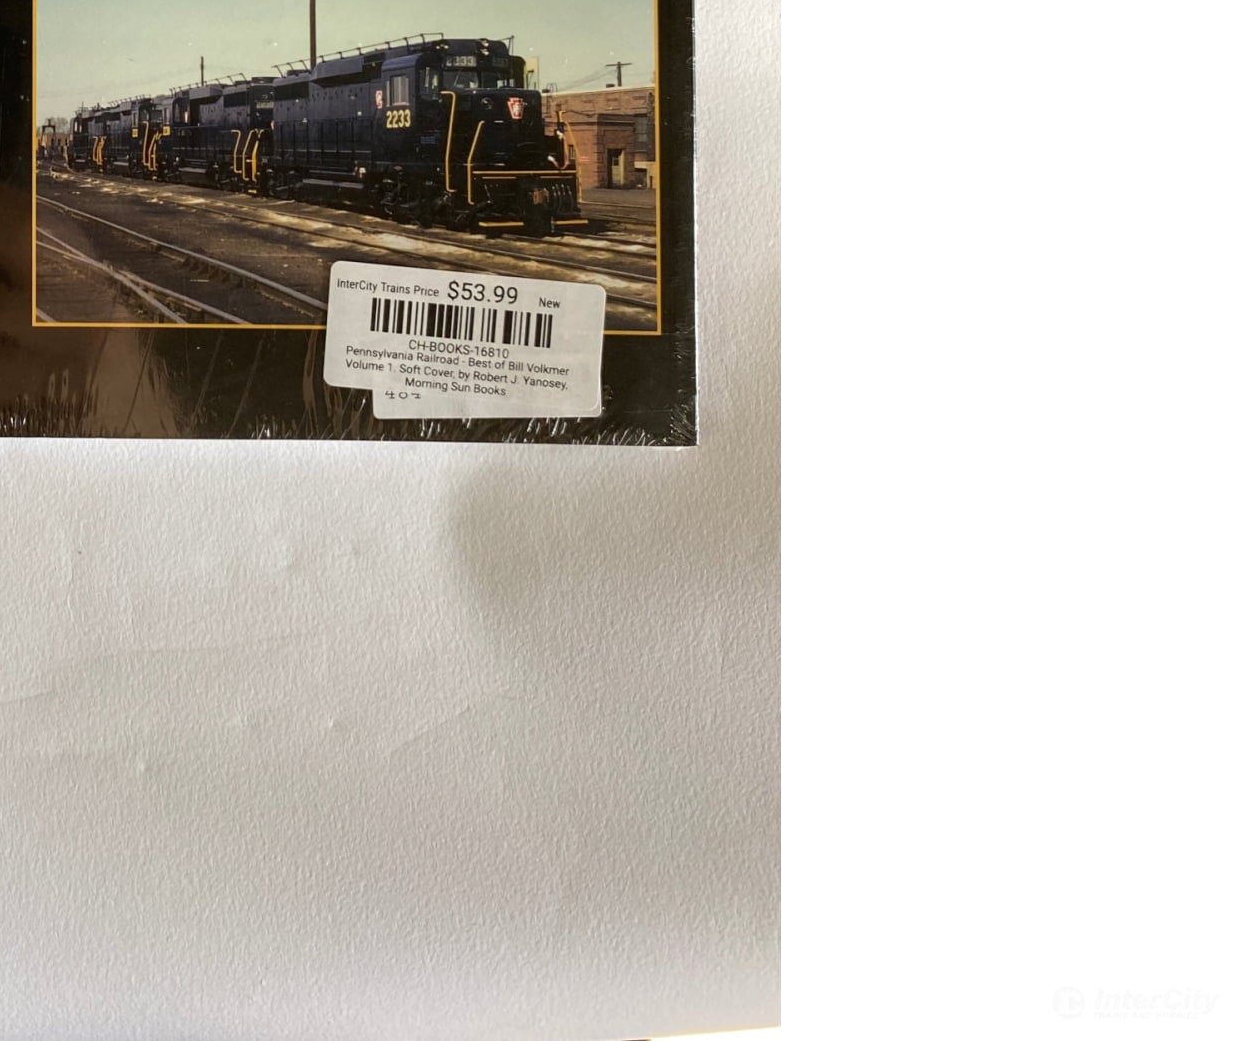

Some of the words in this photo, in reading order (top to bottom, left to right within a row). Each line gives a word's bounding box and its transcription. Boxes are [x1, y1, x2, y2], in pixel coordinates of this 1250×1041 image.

[386, 109, 412, 129] 2233
[337, 278, 378, 294] InterCity
[381, 281, 411, 295] Trains
[413, 285, 440, 297] Price
[447, 280, 519, 305] $53.99
[538, 297, 561, 309] New
[408, 339, 510, 359] CH-BOOKS-16810
[345, 359, 385, 371] Volume
[399, 363, 421, 375] Soft
[458, 369, 470, 382] by
[473, 371, 508, 384] Robert
[346, 345, 414, 362] Pennsylvania
[416, 352, 460, 366] Railroad
[468, 357, 492, 369] Best
[494, 360, 506, 370] of
[508, 361, 524, 372] Bill
[526, 363, 570, 376] Volkmer
[405, 377, 449, 393] Morning
[450, 381, 471, 393] Sun
[473, 383, 507, 396] Books
